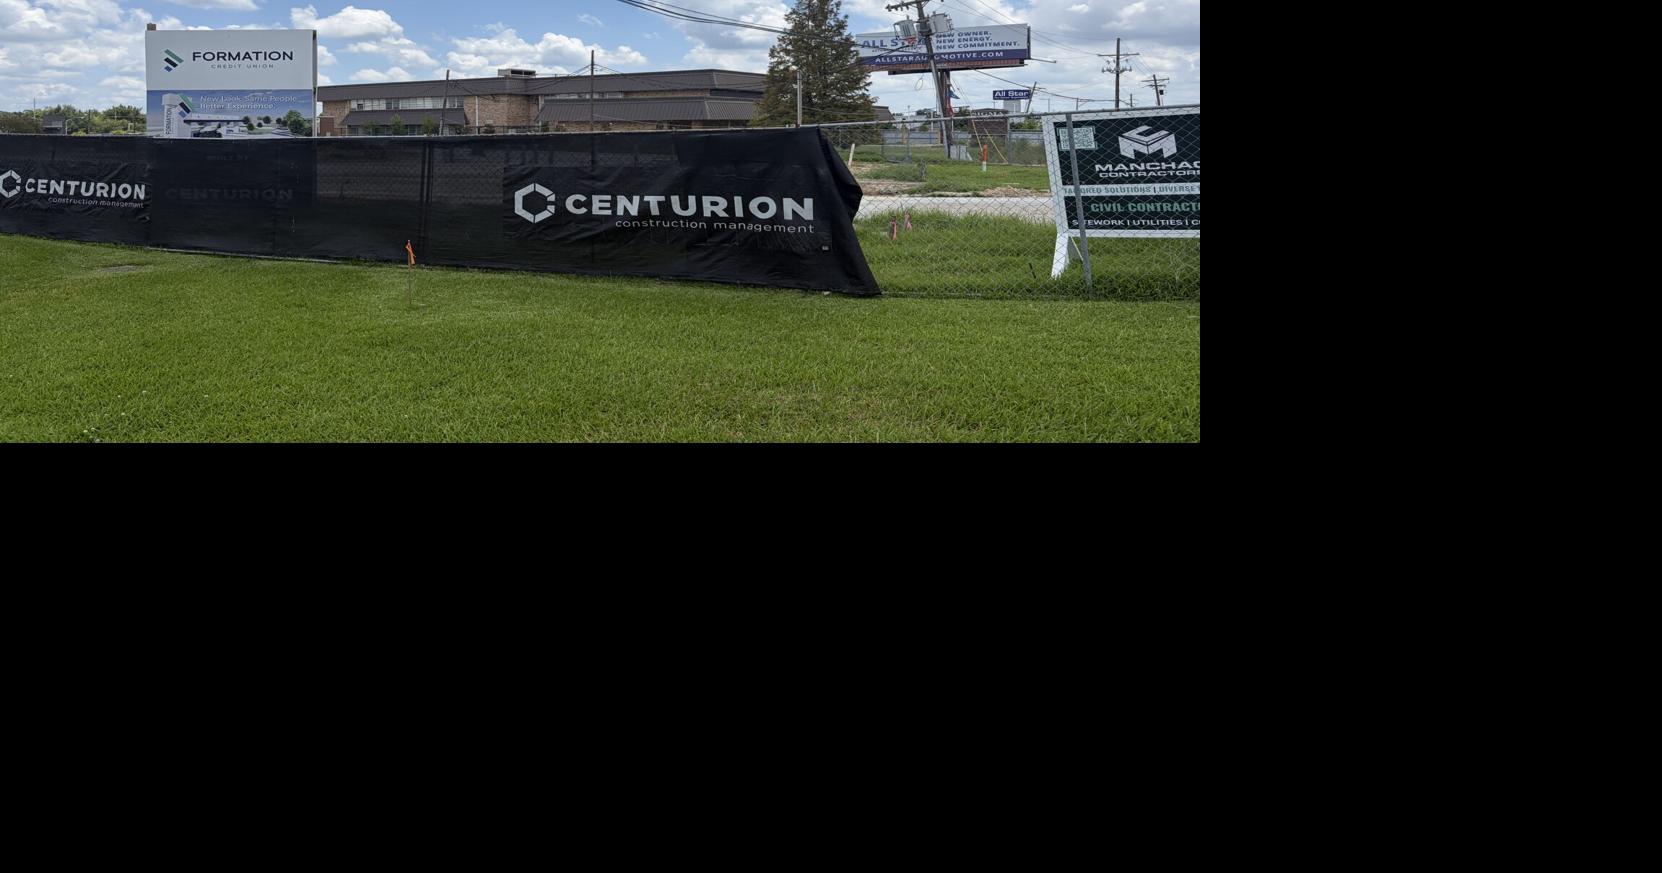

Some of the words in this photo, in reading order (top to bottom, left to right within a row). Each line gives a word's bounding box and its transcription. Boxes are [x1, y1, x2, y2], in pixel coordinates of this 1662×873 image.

[862, 39, 887, 48] ALL
[192, 51, 294, 62] FORMATION
[875, 51, 1004, 63] ALLSTARAUOMOTIVE.COM
[25, 179, 146, 200] CENTURION
[1105, 186, 1151, 194] SOLUTIONS
[48, 197, 98, 206] construction
[100, 200, 144, 208] management
[565, 194, 814, 220] CENTURION
[1091, 202, 1124, 212] CIVIL
[1128, 202, 1200, 212] CONTRACT
[615, 219, 707, 230] construction
[714, 222, 814, 233] management
